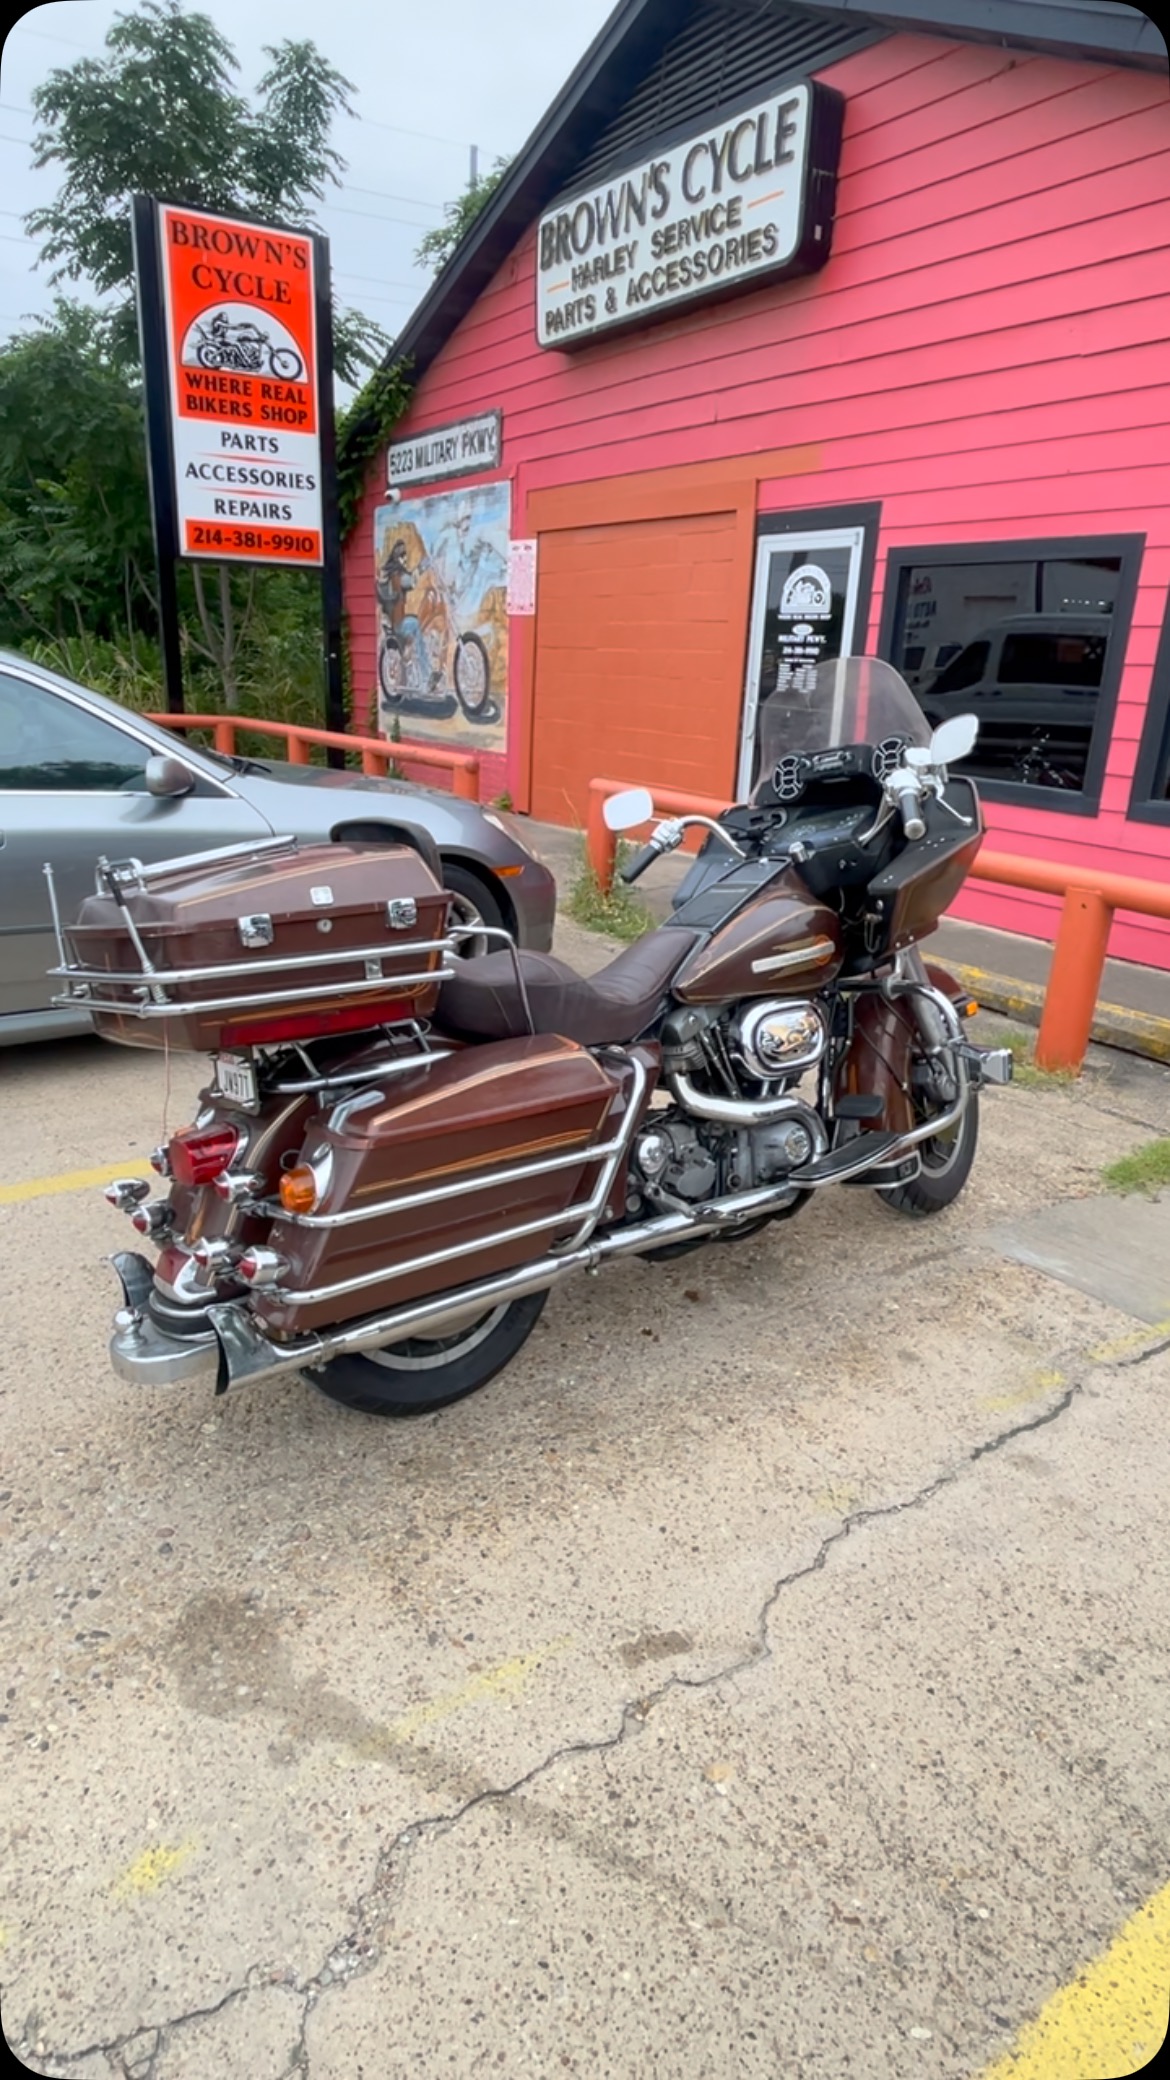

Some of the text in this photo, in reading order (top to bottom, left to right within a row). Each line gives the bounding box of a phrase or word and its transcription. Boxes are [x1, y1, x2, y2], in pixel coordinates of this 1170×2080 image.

[540, 97, 799, 271] BROWN'S CYCLE
[170, 219, 307, 270] BROWN'S
[571, 196, 742, 292] HARLEY SERVICE
[191, 264, 292, 305] CYCLE
[545, 222, 779, 335] PARTS & ACCESSORIES
[185, 372, 307, 405] WHERE REAL
[186, 394, 308, 425] BIKERS SHOP
[221, 431, 279, 453] PARTS
[390, 448, 414, 475] 5223
[415, 435, 459, 469] MILITARY
[185, 462, 316, 490] ACCESSORIES
[214, 499, 292, 521] REPAIRS
[193, 528, 314, 553] 214-381-9910
